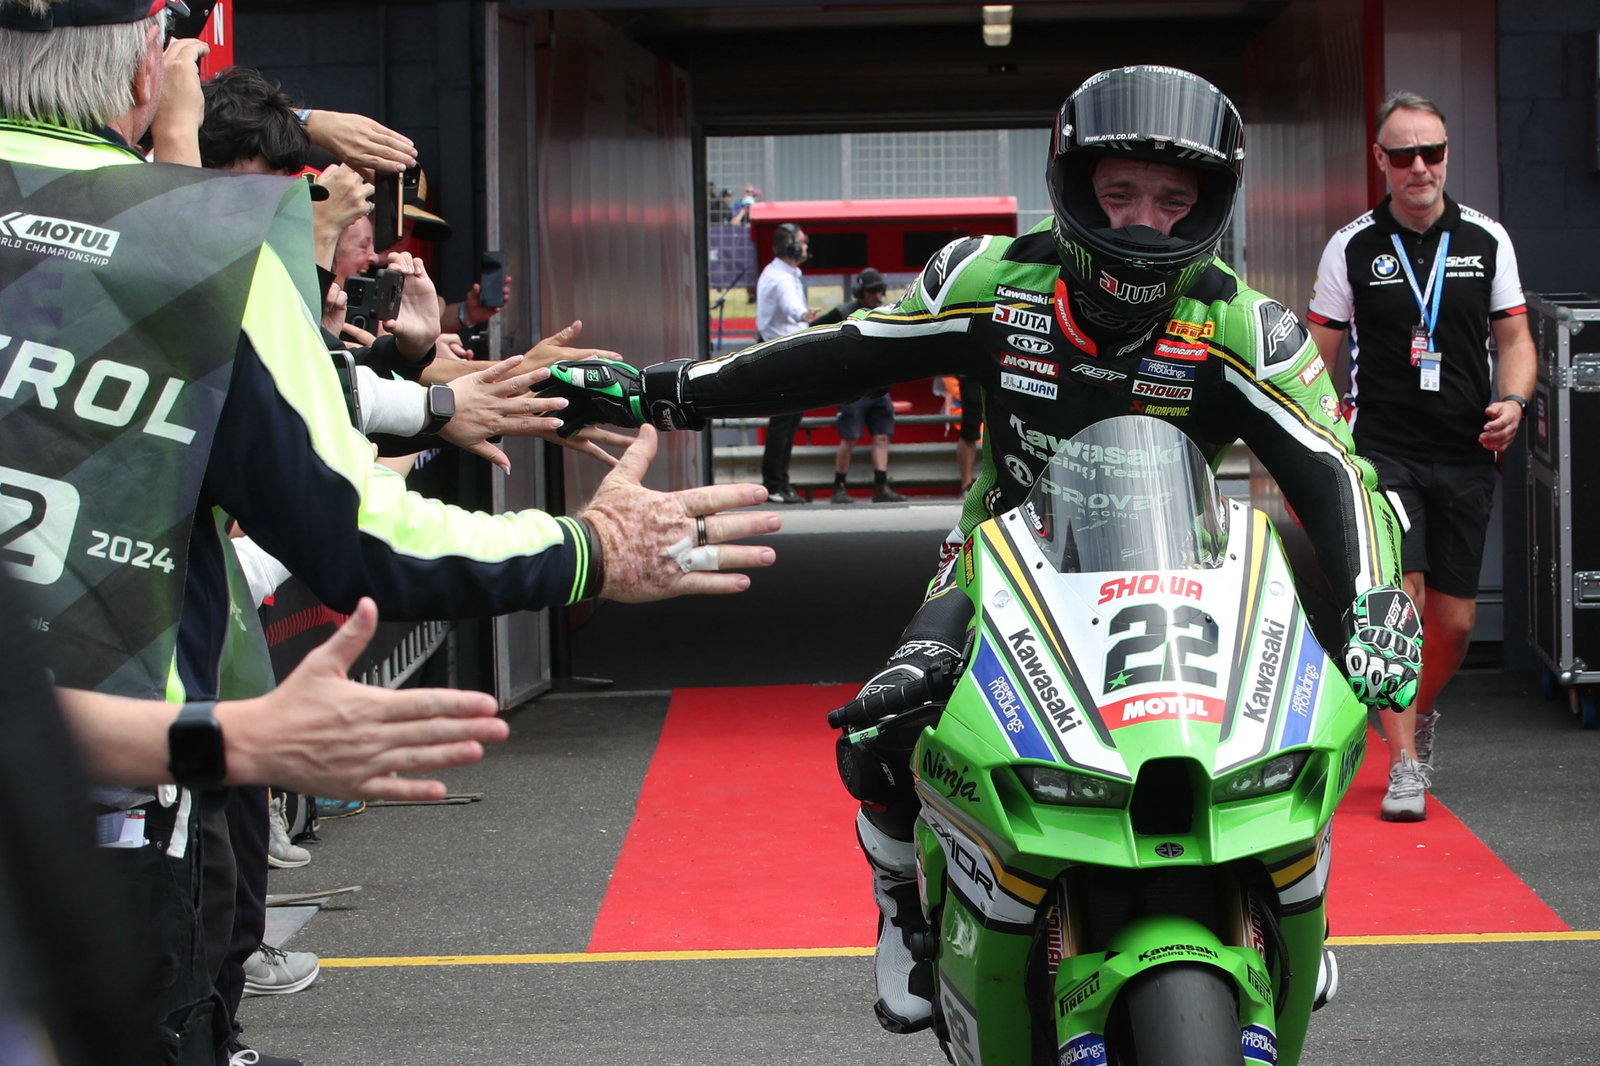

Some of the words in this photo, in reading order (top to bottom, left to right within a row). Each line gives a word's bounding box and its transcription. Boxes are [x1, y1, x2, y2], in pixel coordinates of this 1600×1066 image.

[1143, 65, 1197, 81] TITANTECH
[25, 220, 111, 252] MOTUL
[0, 237, 22, 249] RLD
[25, 242, 110, 266] CHAMPIONSHIP
[996, 286, 1048, 305] Kawasaki
[1117, 282, 1167, 304] JUTA
[1010, 311, 1048, 332] JUTA
[1013, 336, 1050, 352] KYT
[1003, 355, 1056, 376] MOTUL
[1071, 363, 1128, 381] RST
[0, 334, 197, 445] ROL
[1017, 379, 1056, 397] J.JUAN
[1133, 382, 1191, 399] SHOWA
[87, 530, 175, 574] 2024
[1098, 574, 1203, 605] SHOWA
[1102, 603, 1219, 695] 22
[1008, 627, 1083, 734] Kawasaki
[1243, 617, 1285, 723] Kawasaki
[1297, 662, 1319, 718] mouldings
[988, 679, 1025, 733] mouldings
[1122, 696, 1208, 721] MOTUL
[923, 748, 981, 803] Ninja
[1138, 944, 1219, 963] Kawasaki
[1148, 950, 1185, 963] Racing
[1187, 949, 1212, 960] Team
[1058, 971, 1101, 1018] PIRELLI
